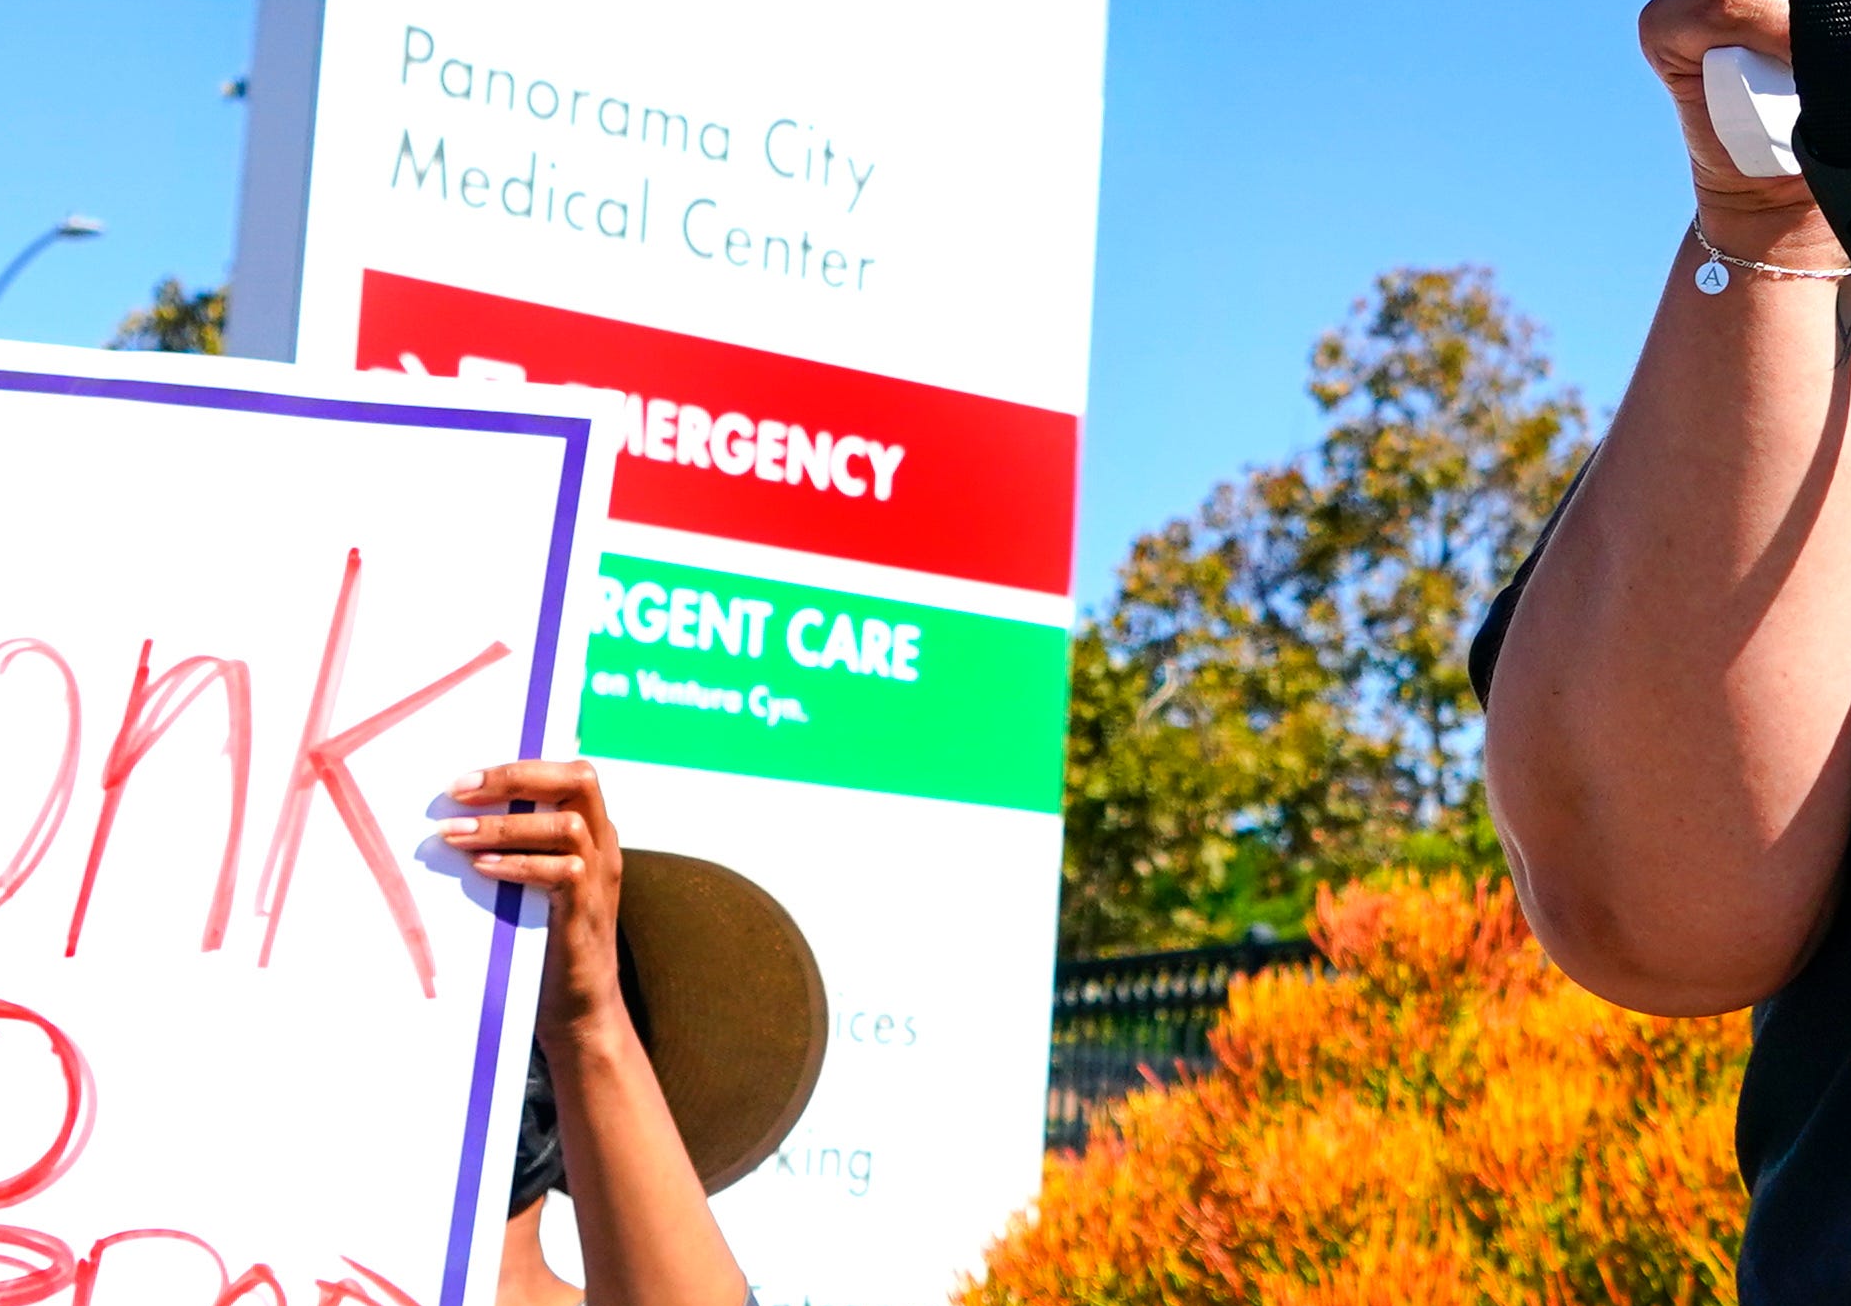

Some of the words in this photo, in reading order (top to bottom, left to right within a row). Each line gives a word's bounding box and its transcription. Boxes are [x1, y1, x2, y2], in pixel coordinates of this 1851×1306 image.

[400, 25, 732, 163] Panorama
[763, 117, 876, 213] City
[390, 128, 650, 244] Medical
[682, 198, 876, 292] Center
[620, 391, 905, 502] MERGENCY
[591, 575, 775, 659] RGENT
[786, 606, 922, 683] CARE
[636, 668, 744, 715] Ventura
